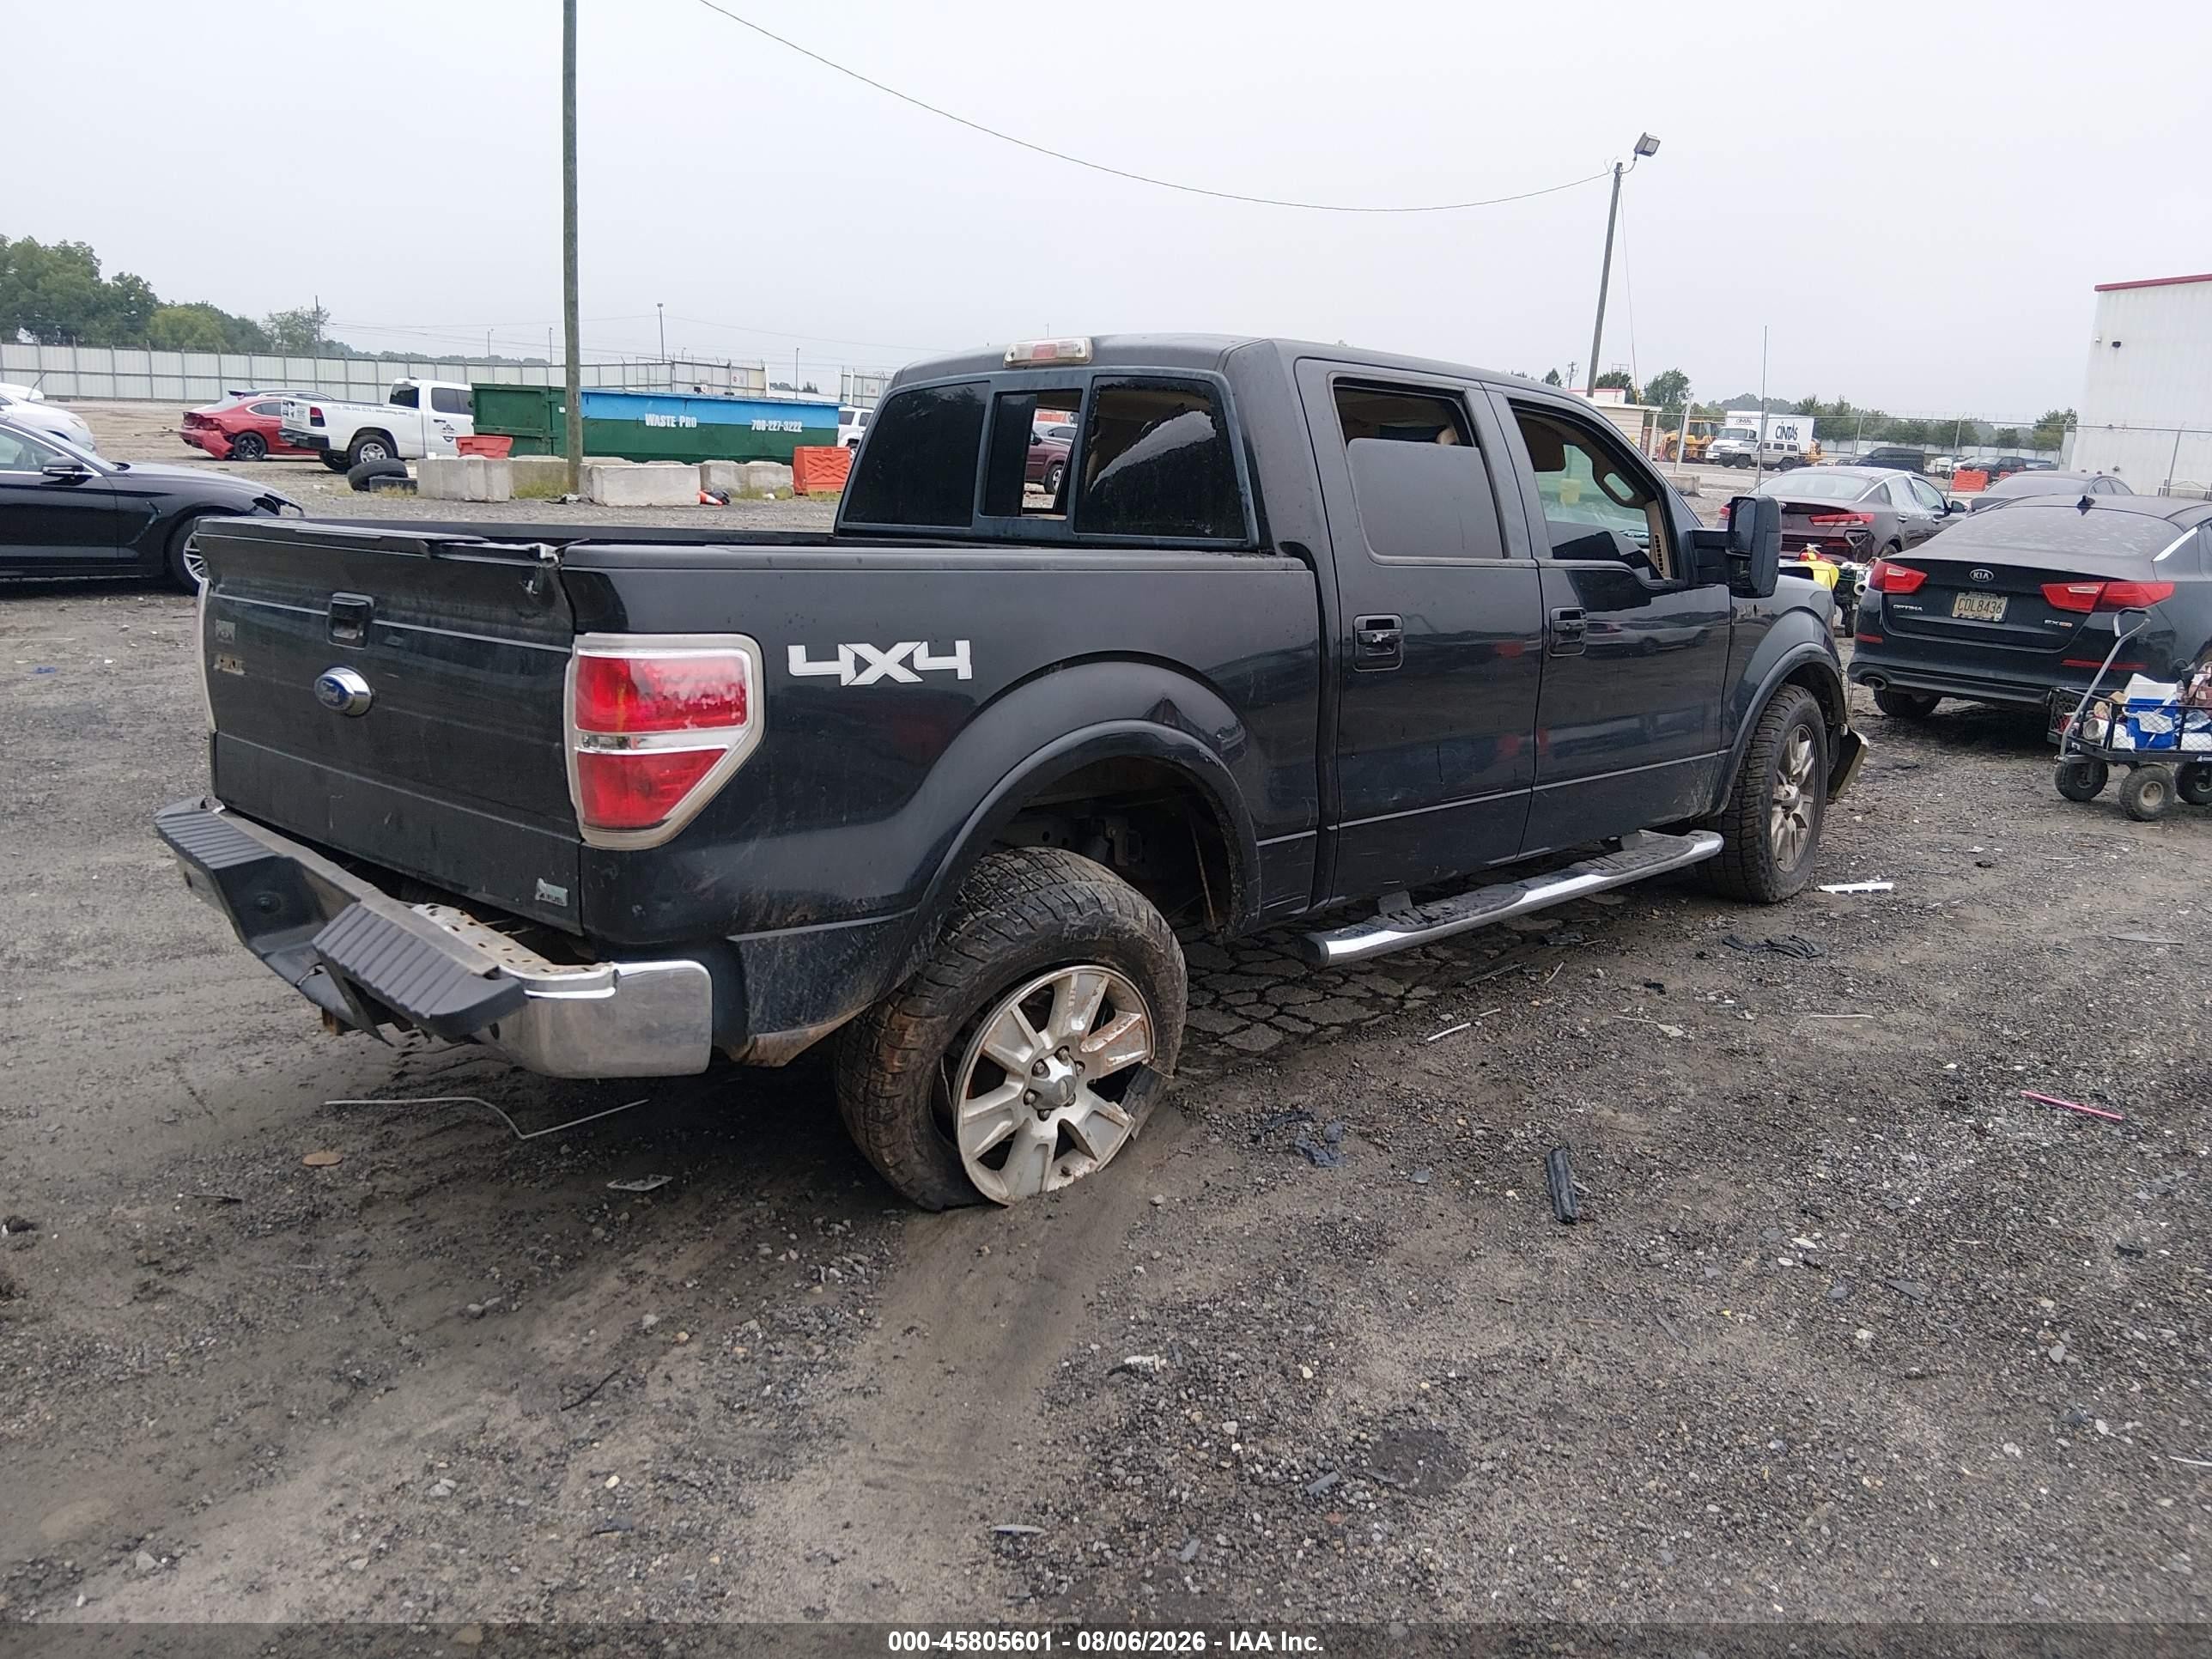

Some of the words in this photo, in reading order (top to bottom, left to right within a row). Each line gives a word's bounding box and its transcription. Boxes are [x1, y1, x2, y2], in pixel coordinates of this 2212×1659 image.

[645, 413, 677, 428] WASTE
[678, 415, 697, 428] PRO
[1893, 604, 1923, 612] OPTIMA
[1957, 598, 2003, 614] CDL8436
[787, 640, 973, 686] 4X4
